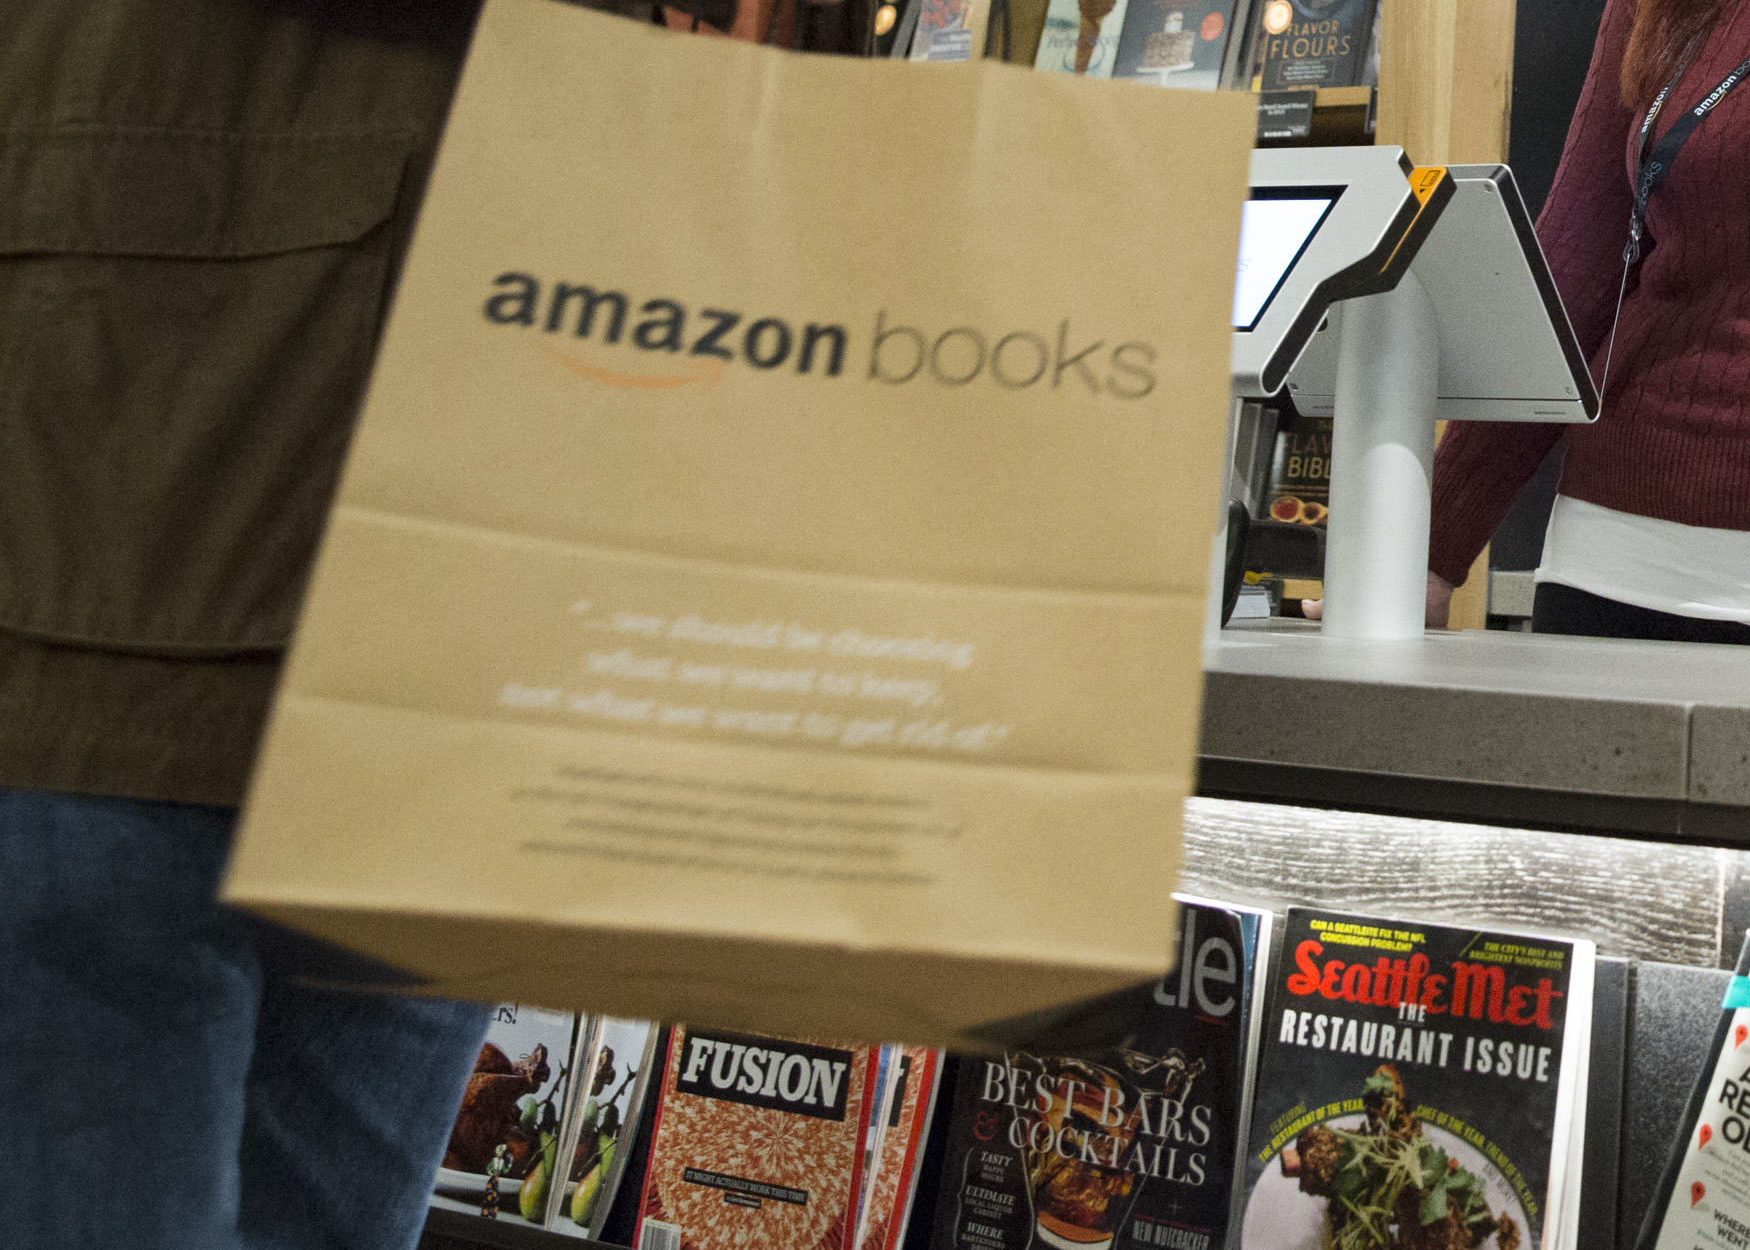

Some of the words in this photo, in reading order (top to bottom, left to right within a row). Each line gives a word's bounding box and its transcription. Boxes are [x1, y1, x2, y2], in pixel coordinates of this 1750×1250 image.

[1270, 35, 1351, 59] FLOURS
[1694, 74, 1738, 116] amazon
[481, 269, 852, 379] amazon
[864, 308, 1160, 401] books
[1394, 930, 1410, 941] THE
[1153, 907, 1237, 1017] le
[1287, 940, 1448, 1014] Seattle
[1450, 961, 1564, 1030] Met
[1398, 1002, 1428, 1023] THE
[1279, 1009, 1453, 1068] RESTAURANT
[1464, 1036, 1552, 1083] ISSUE
[682, 1036, 847, 1108] FUSION
[980, 1061, 1086, 1120] BEST
[1099, 1086, 1212, 1147] BARS
[1326, 1101, 1341, 1116] THE
[1448, 1116, 1465, 1134] THE
[973, 1111, 998, 1141] &
[1008, 1116, 1207, 1186] COCKTAILS
[981, 1151, 1013, 1167] TASTY
[966, 1185, 1016, 1206] ULTIMATE
[968, 1222, 1004, 1239] WHERE
